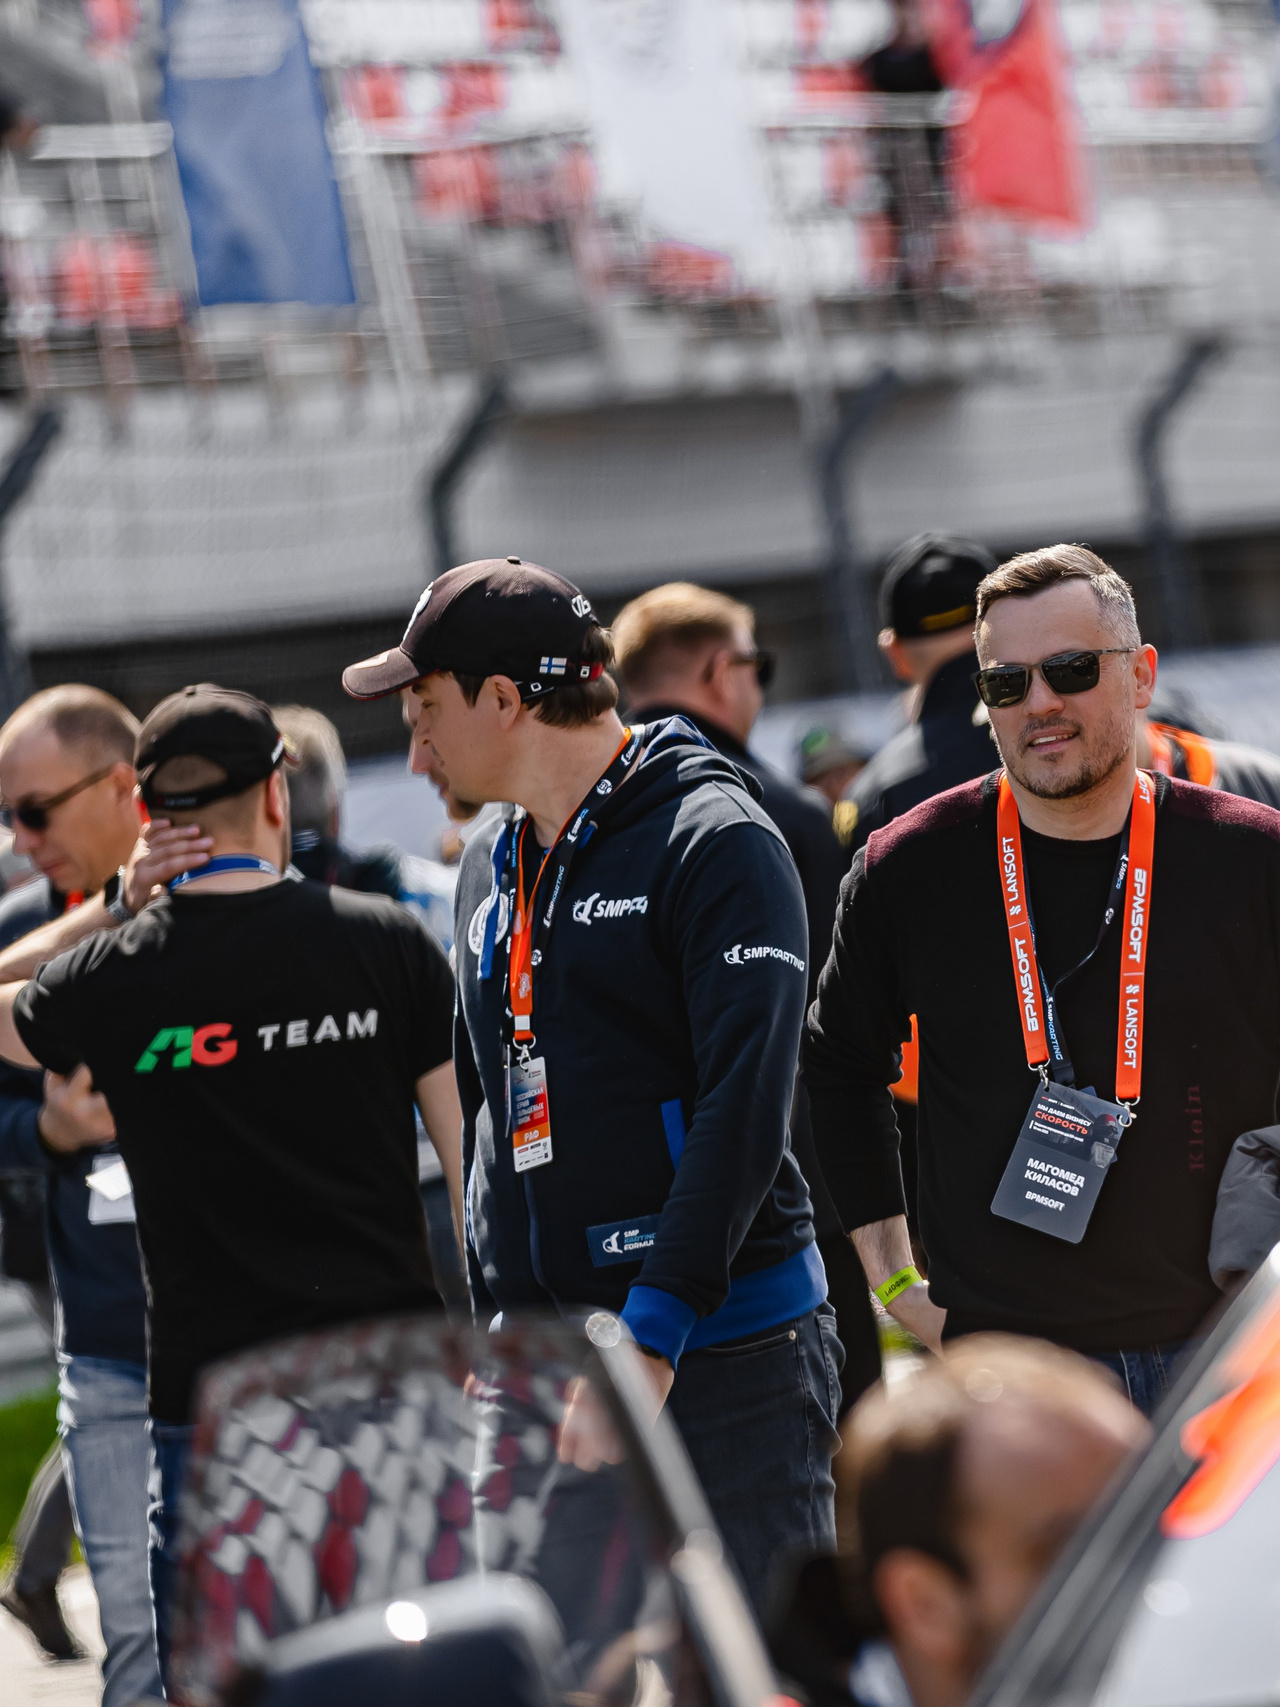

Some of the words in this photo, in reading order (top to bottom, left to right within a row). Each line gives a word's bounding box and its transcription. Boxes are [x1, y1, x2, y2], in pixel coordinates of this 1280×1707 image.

[1001, 836, 1019, 903] LANSOFT
[1127, 867, 1147, 963] BPMSOFT
[743, 946, 806, 972] SMPKARTING
[1015, 937, 1039, 1032] BPMSOFT
[257, 1008, 379, 1051] TEAM
[1124, 998, 1139, 1069] LANSOFT
[1034, 1110, 1088, 1135] СКОРОСТЬ
[1024, 1169, 1080, 1197] КИЛАСОВ
[1026, 1157, 1085, 1188] МАГОМЕД
[1025, 1190, 1065, 1212] BPMSOFT
[623, 1228, 640, 1238] SMP
